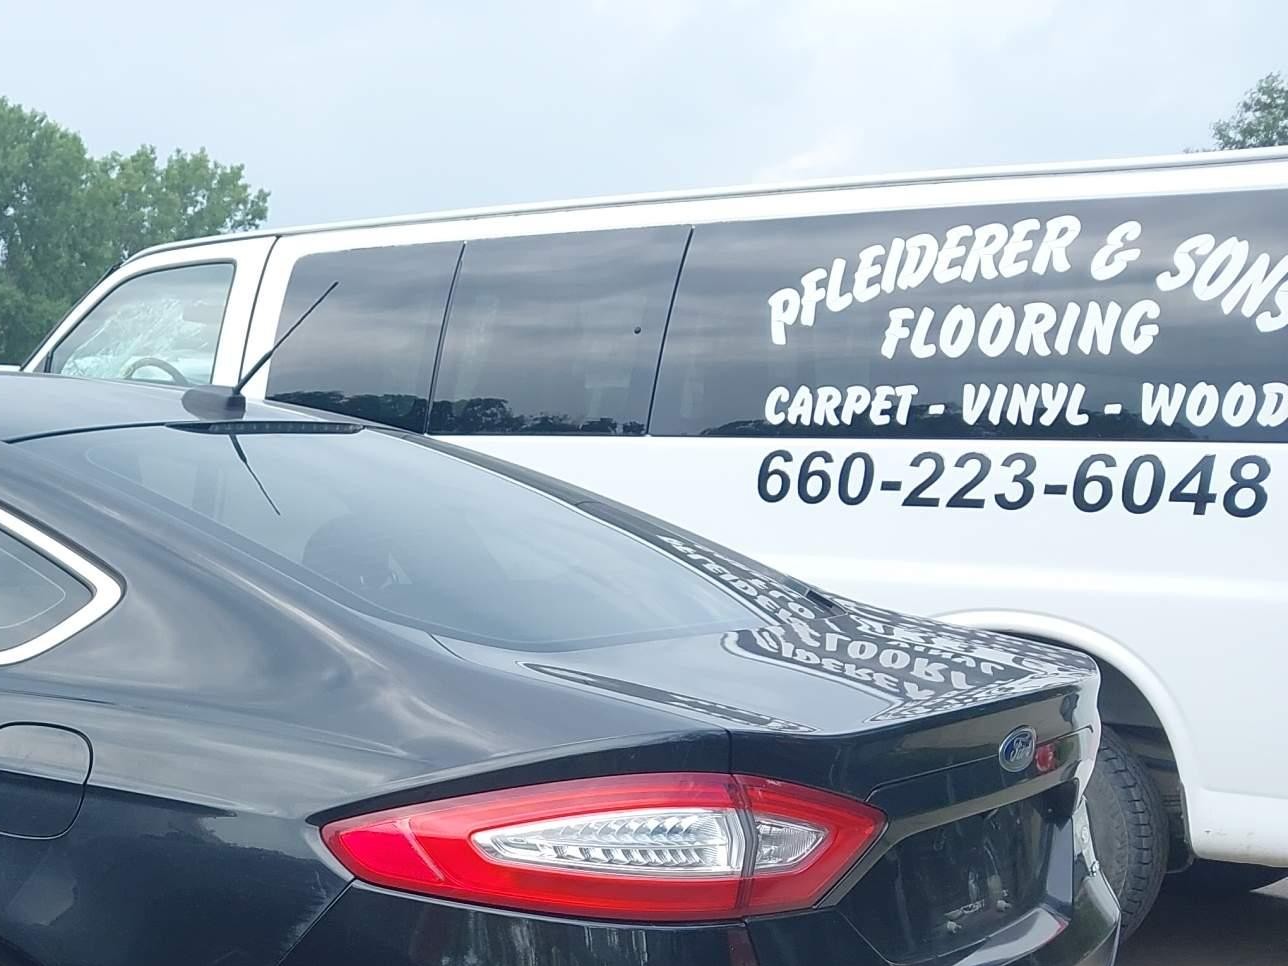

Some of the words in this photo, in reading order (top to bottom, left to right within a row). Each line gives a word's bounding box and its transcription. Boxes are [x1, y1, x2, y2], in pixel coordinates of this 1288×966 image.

[768, 214, 1082, 345] PFLEIDERER
[1090, 220, 1143, 281] &
[880, 300, 1161, 359] FLOORING
[764, 384, 919, 427] CARPET
[962, 382, 1090, 427] VINYL
[1141, 381, 1288, 428] WOOD
[757, 449, 1272, 519] 660-223-6048
